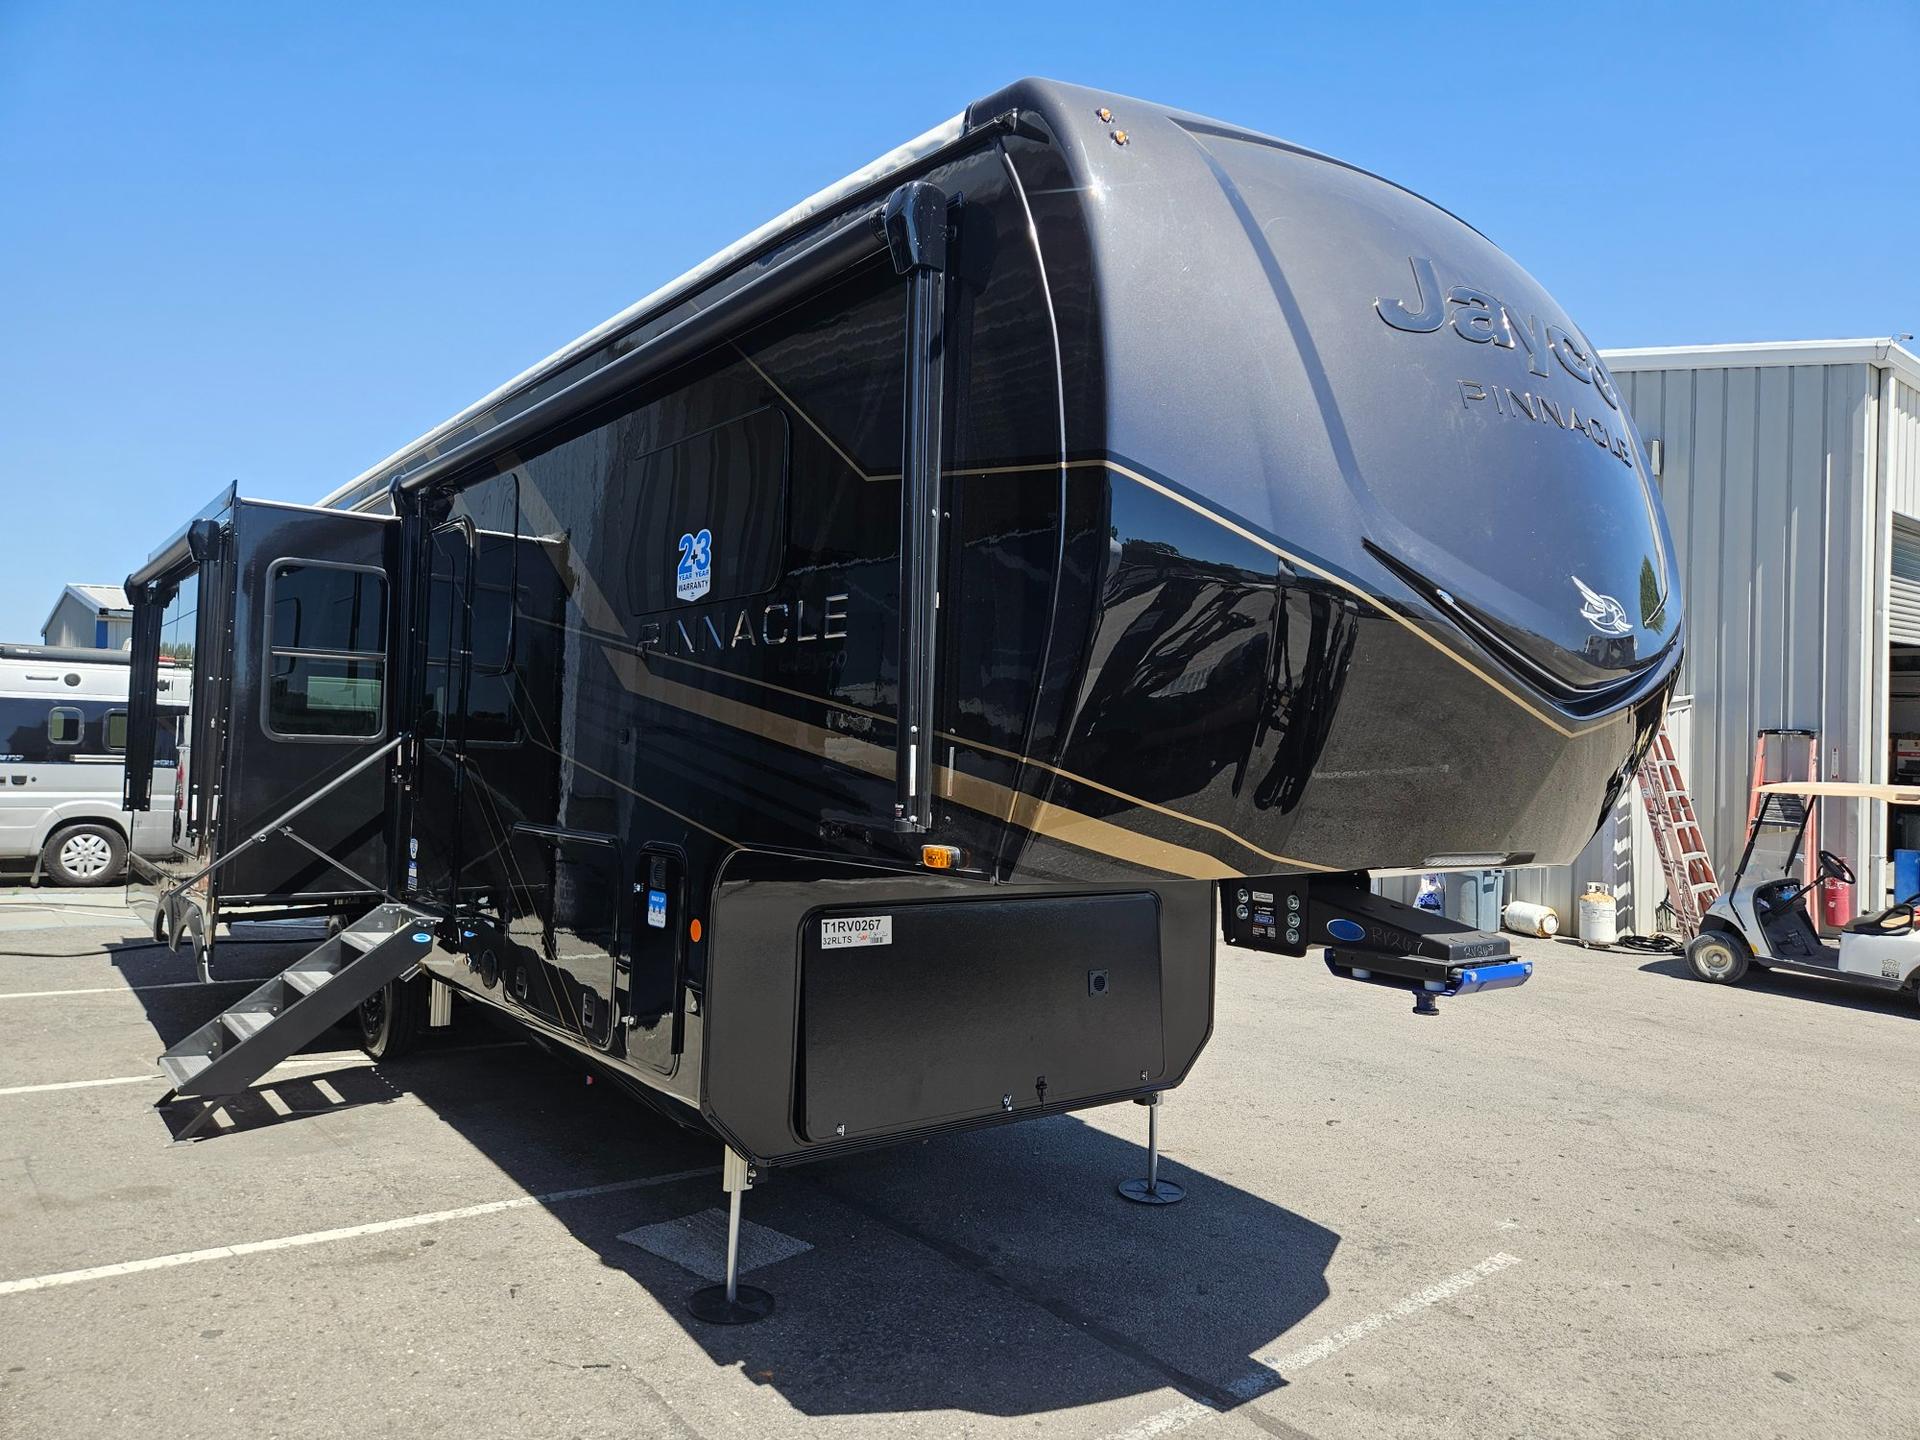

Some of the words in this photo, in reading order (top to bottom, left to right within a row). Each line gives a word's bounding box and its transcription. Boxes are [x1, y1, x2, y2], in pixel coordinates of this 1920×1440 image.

[1373, 256, 1618, 411] Jayco
[1456, 379, 1633, 468] PINNACLE
[679, 573, 692, 582] YEAR
[695, 569, 709, 578] YEAR
[678, 580, 709, 592] WARRANTY
[639, 593, 849, 656] PINNACLE
[823, 920, 881, 933] T1RV0267
[823, 935, 852, 945] 32RLTS
